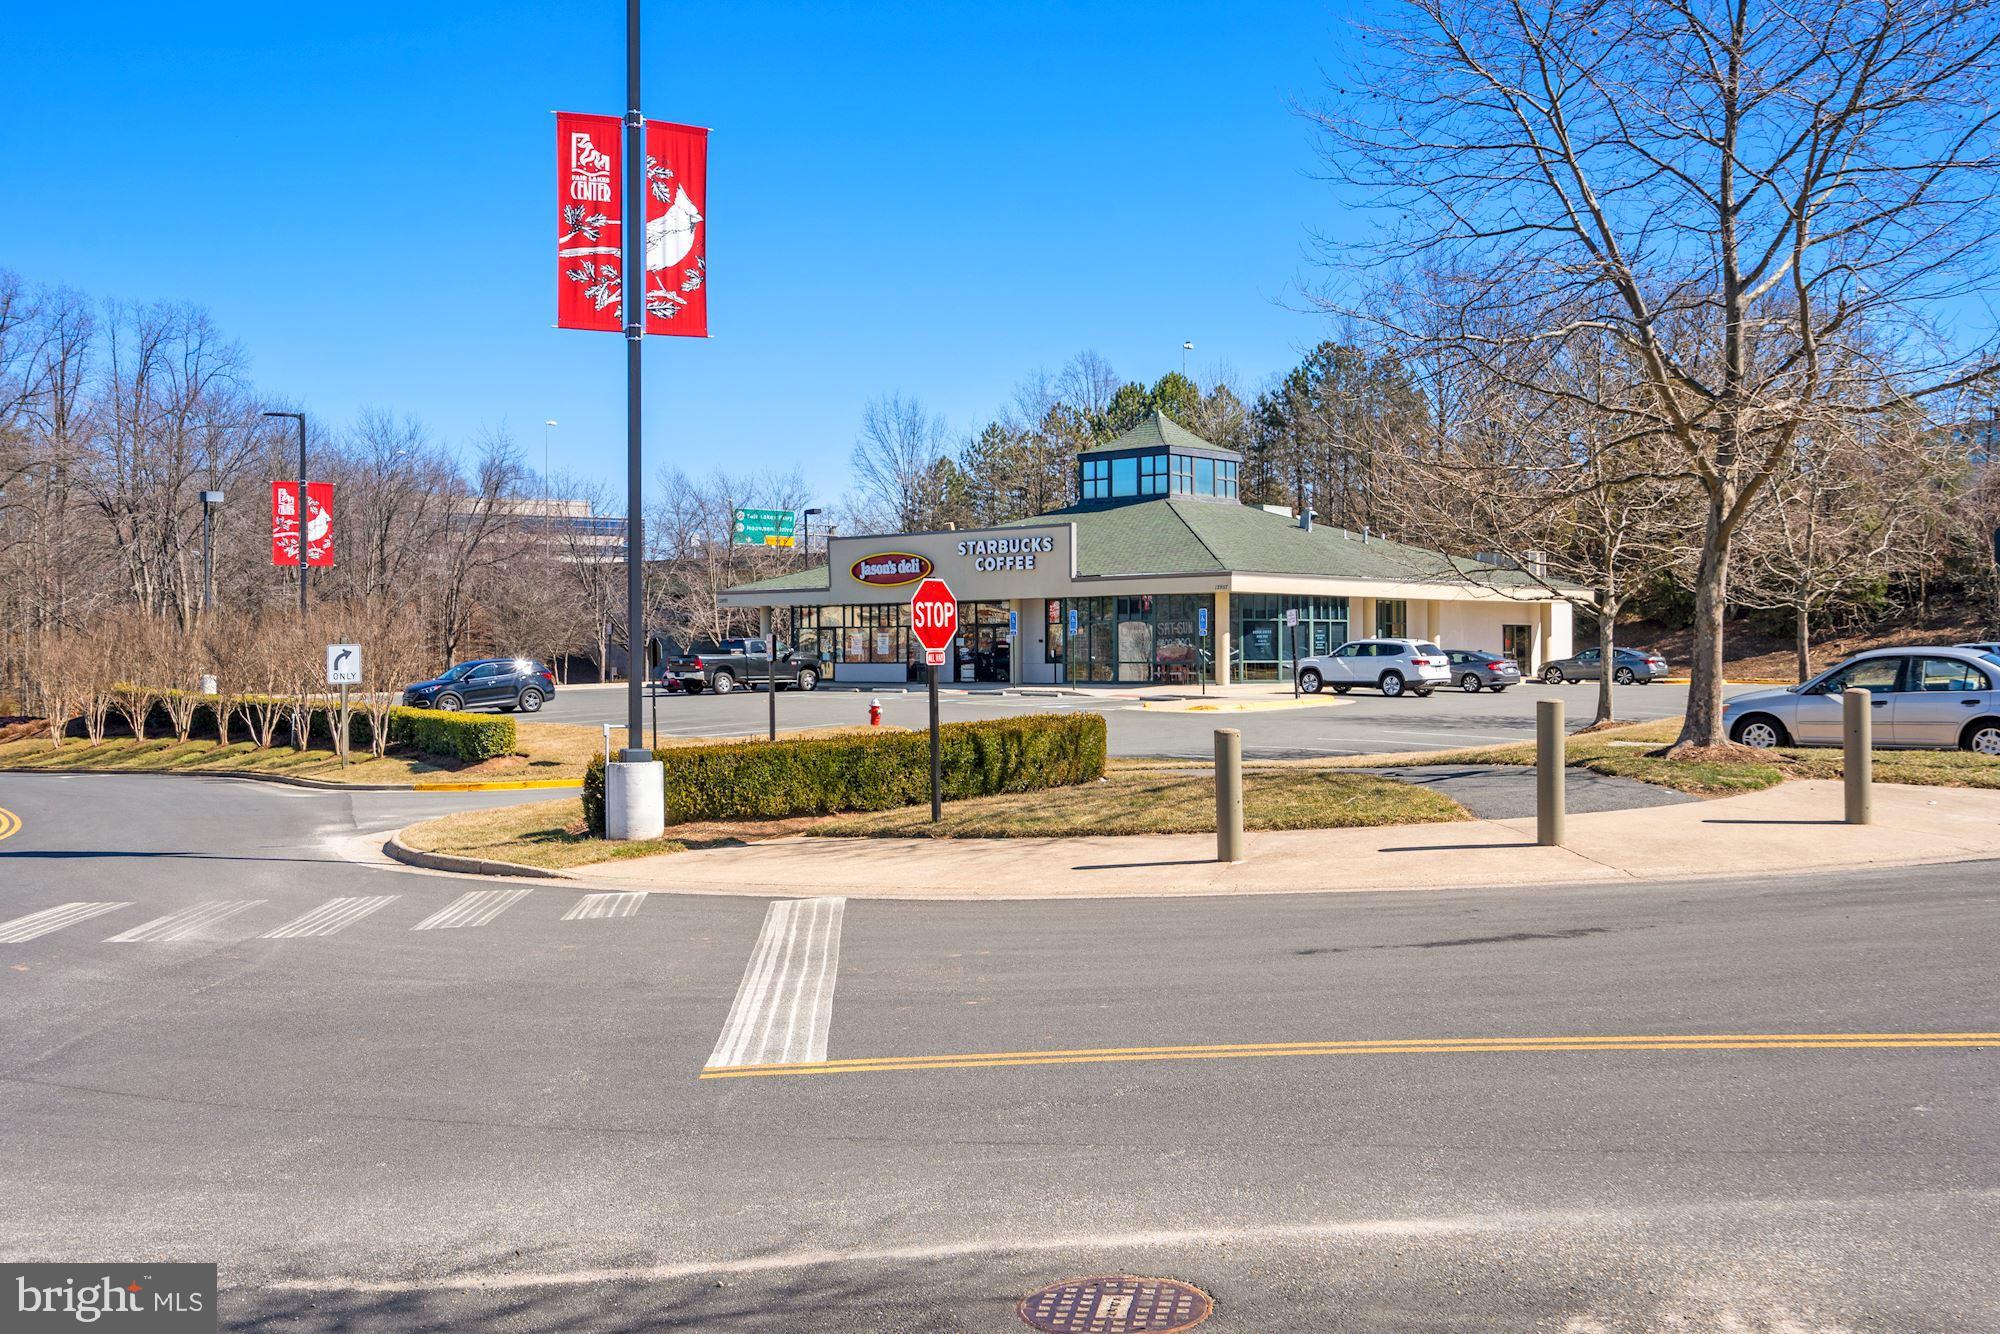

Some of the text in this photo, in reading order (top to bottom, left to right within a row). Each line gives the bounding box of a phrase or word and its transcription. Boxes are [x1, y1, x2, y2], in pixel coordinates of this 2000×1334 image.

[570, 180, 612, 202] CENTER
[957, 537, 1053, 556] STARBUCKS
[897, 558, 921, 574] deli
[974, 555, 1036, 572] COFFEE
[915, 601, 955, 628] STOP
[333, 672, 357, 680] ONLY
